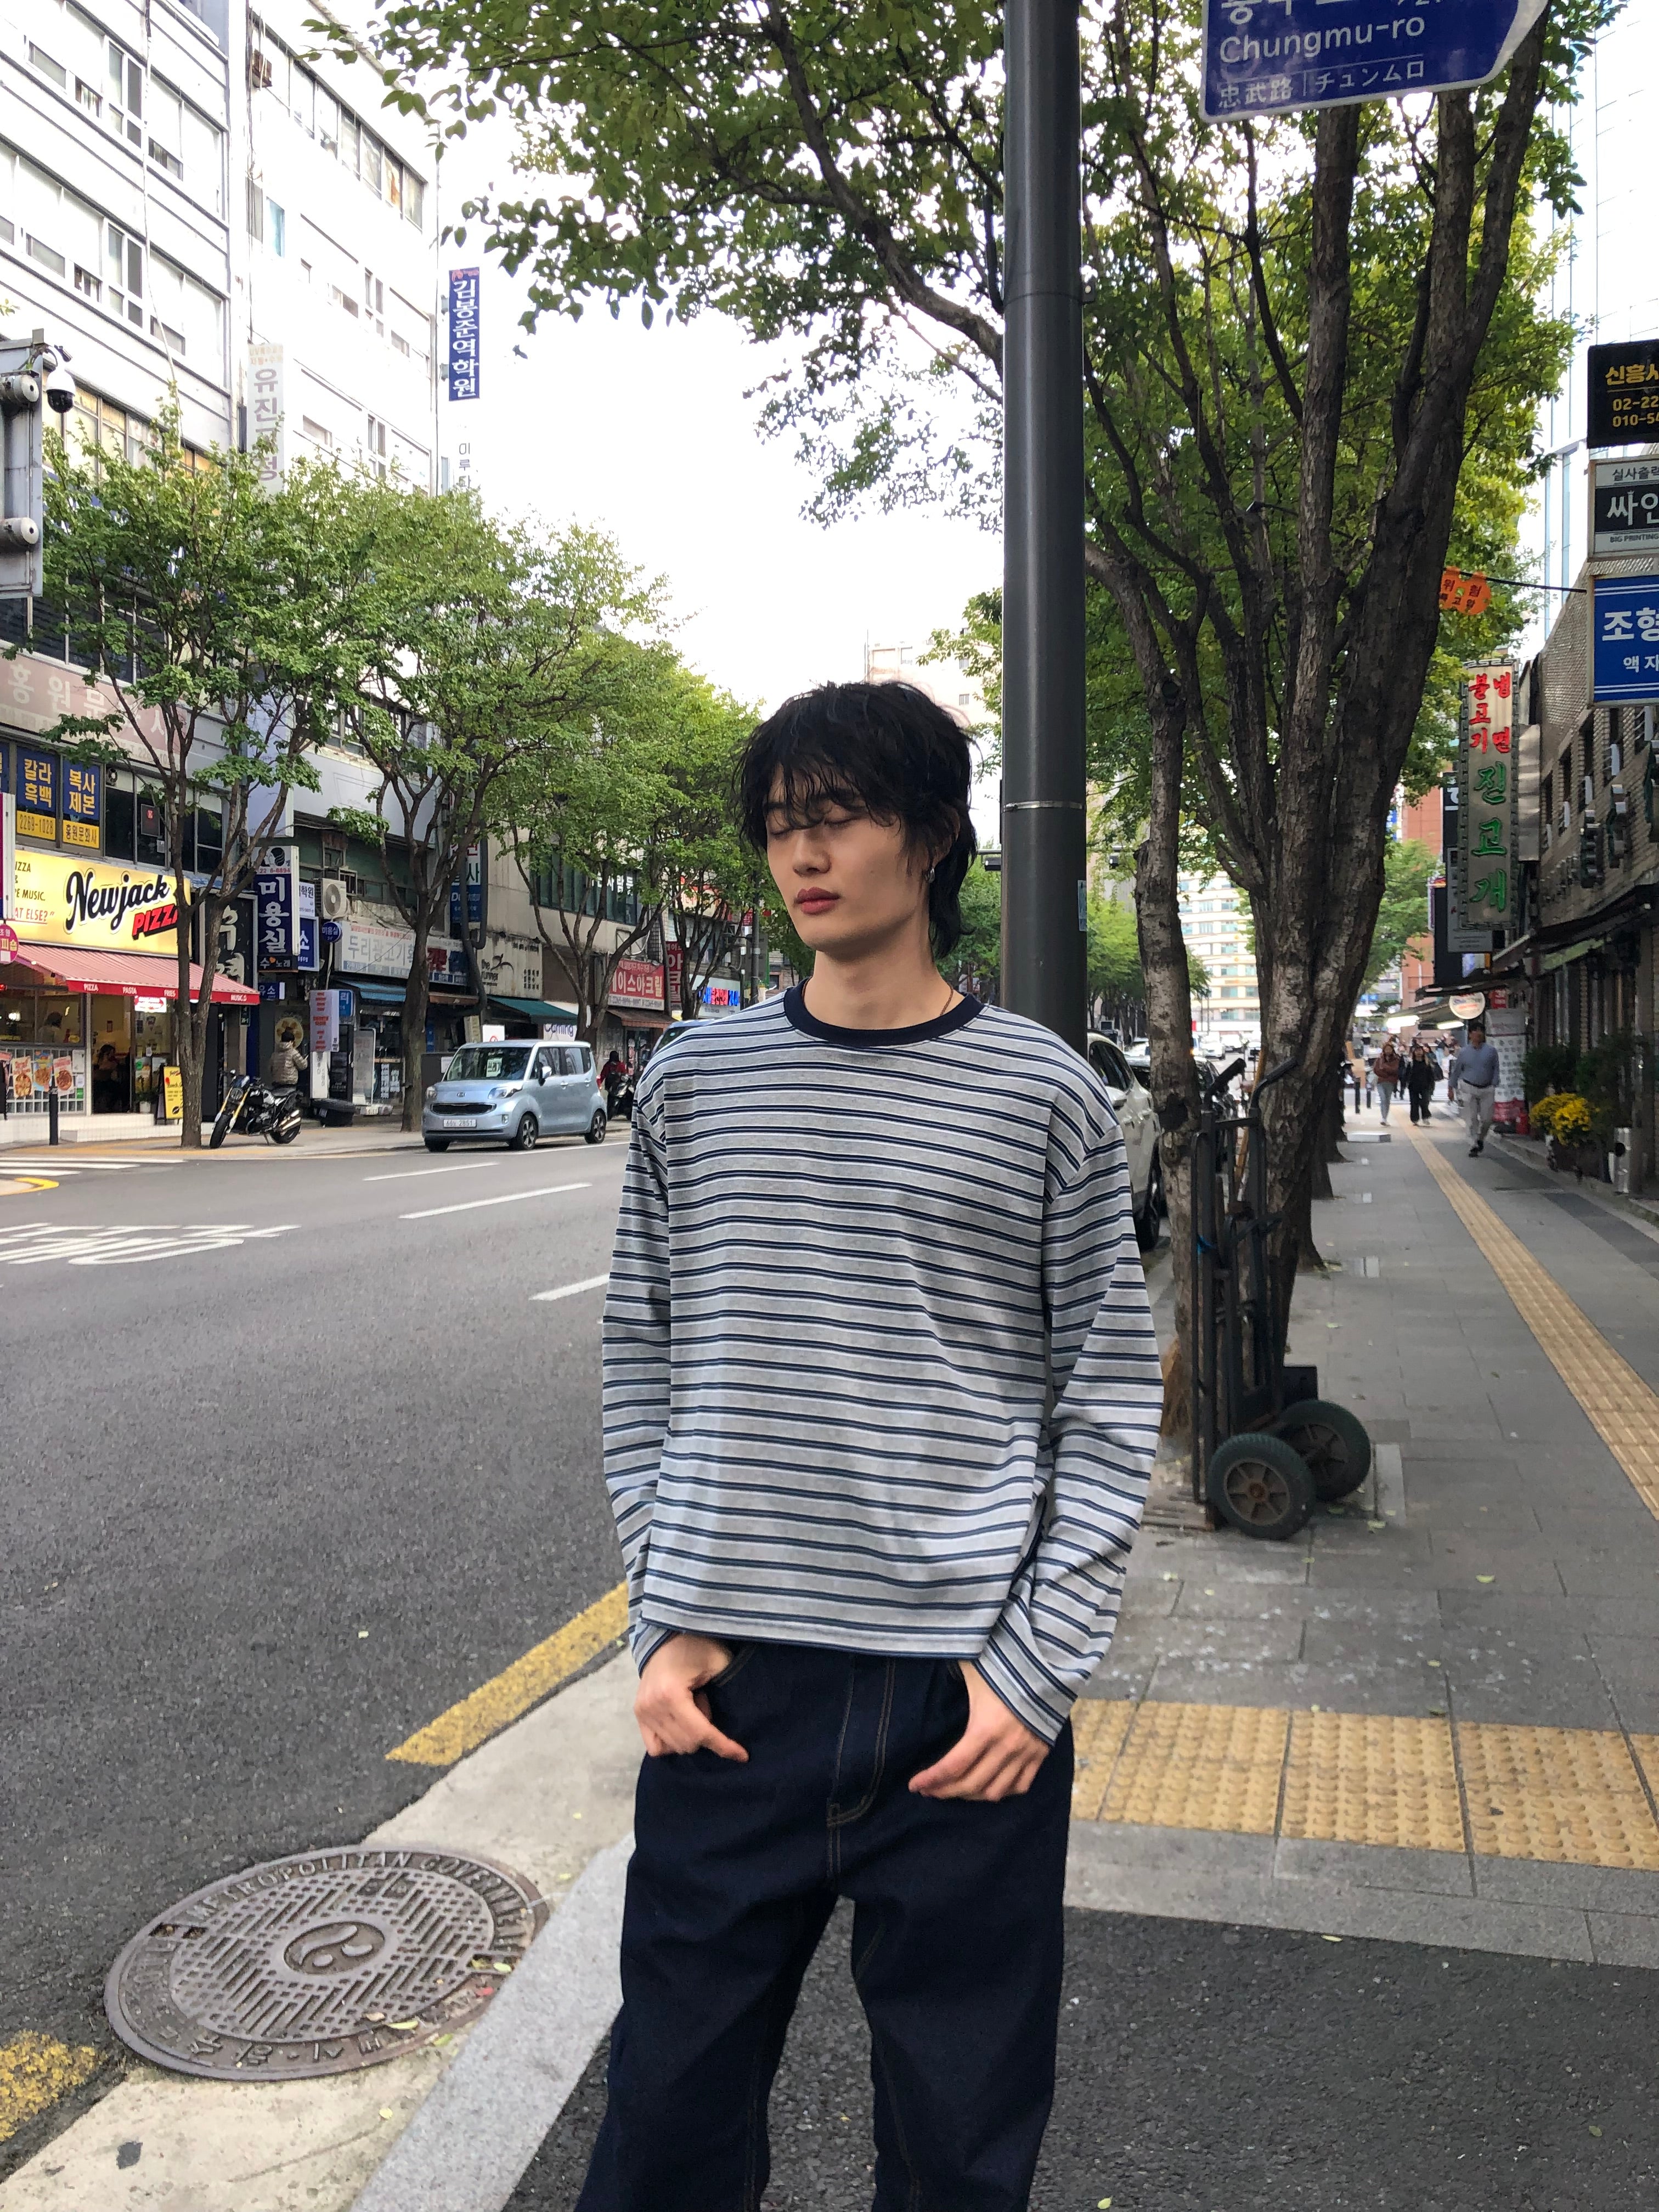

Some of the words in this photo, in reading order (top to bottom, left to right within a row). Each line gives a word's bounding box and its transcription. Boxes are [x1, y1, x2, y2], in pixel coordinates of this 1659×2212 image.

[1219, 16, 1425, 65] Chungmu-ro
[1218, 78, 1294, 109] 忠武路
[1468, 673, 1491, 754] 불고기
[24, 758, 52, 784] 칼라
[69, 769, 95, 794] 복사
[25, 783, 52, 808] 흑백
[69, 791, 95, 815] 제본
[1471, 760, 1508, 913] 진고개
[66, 871, 170, 930] Newjack
[257, 876, 290, 953] 미용실
[83, 983, 99, 991] PIZZA
[122, 986, 137, 995] PASTA
